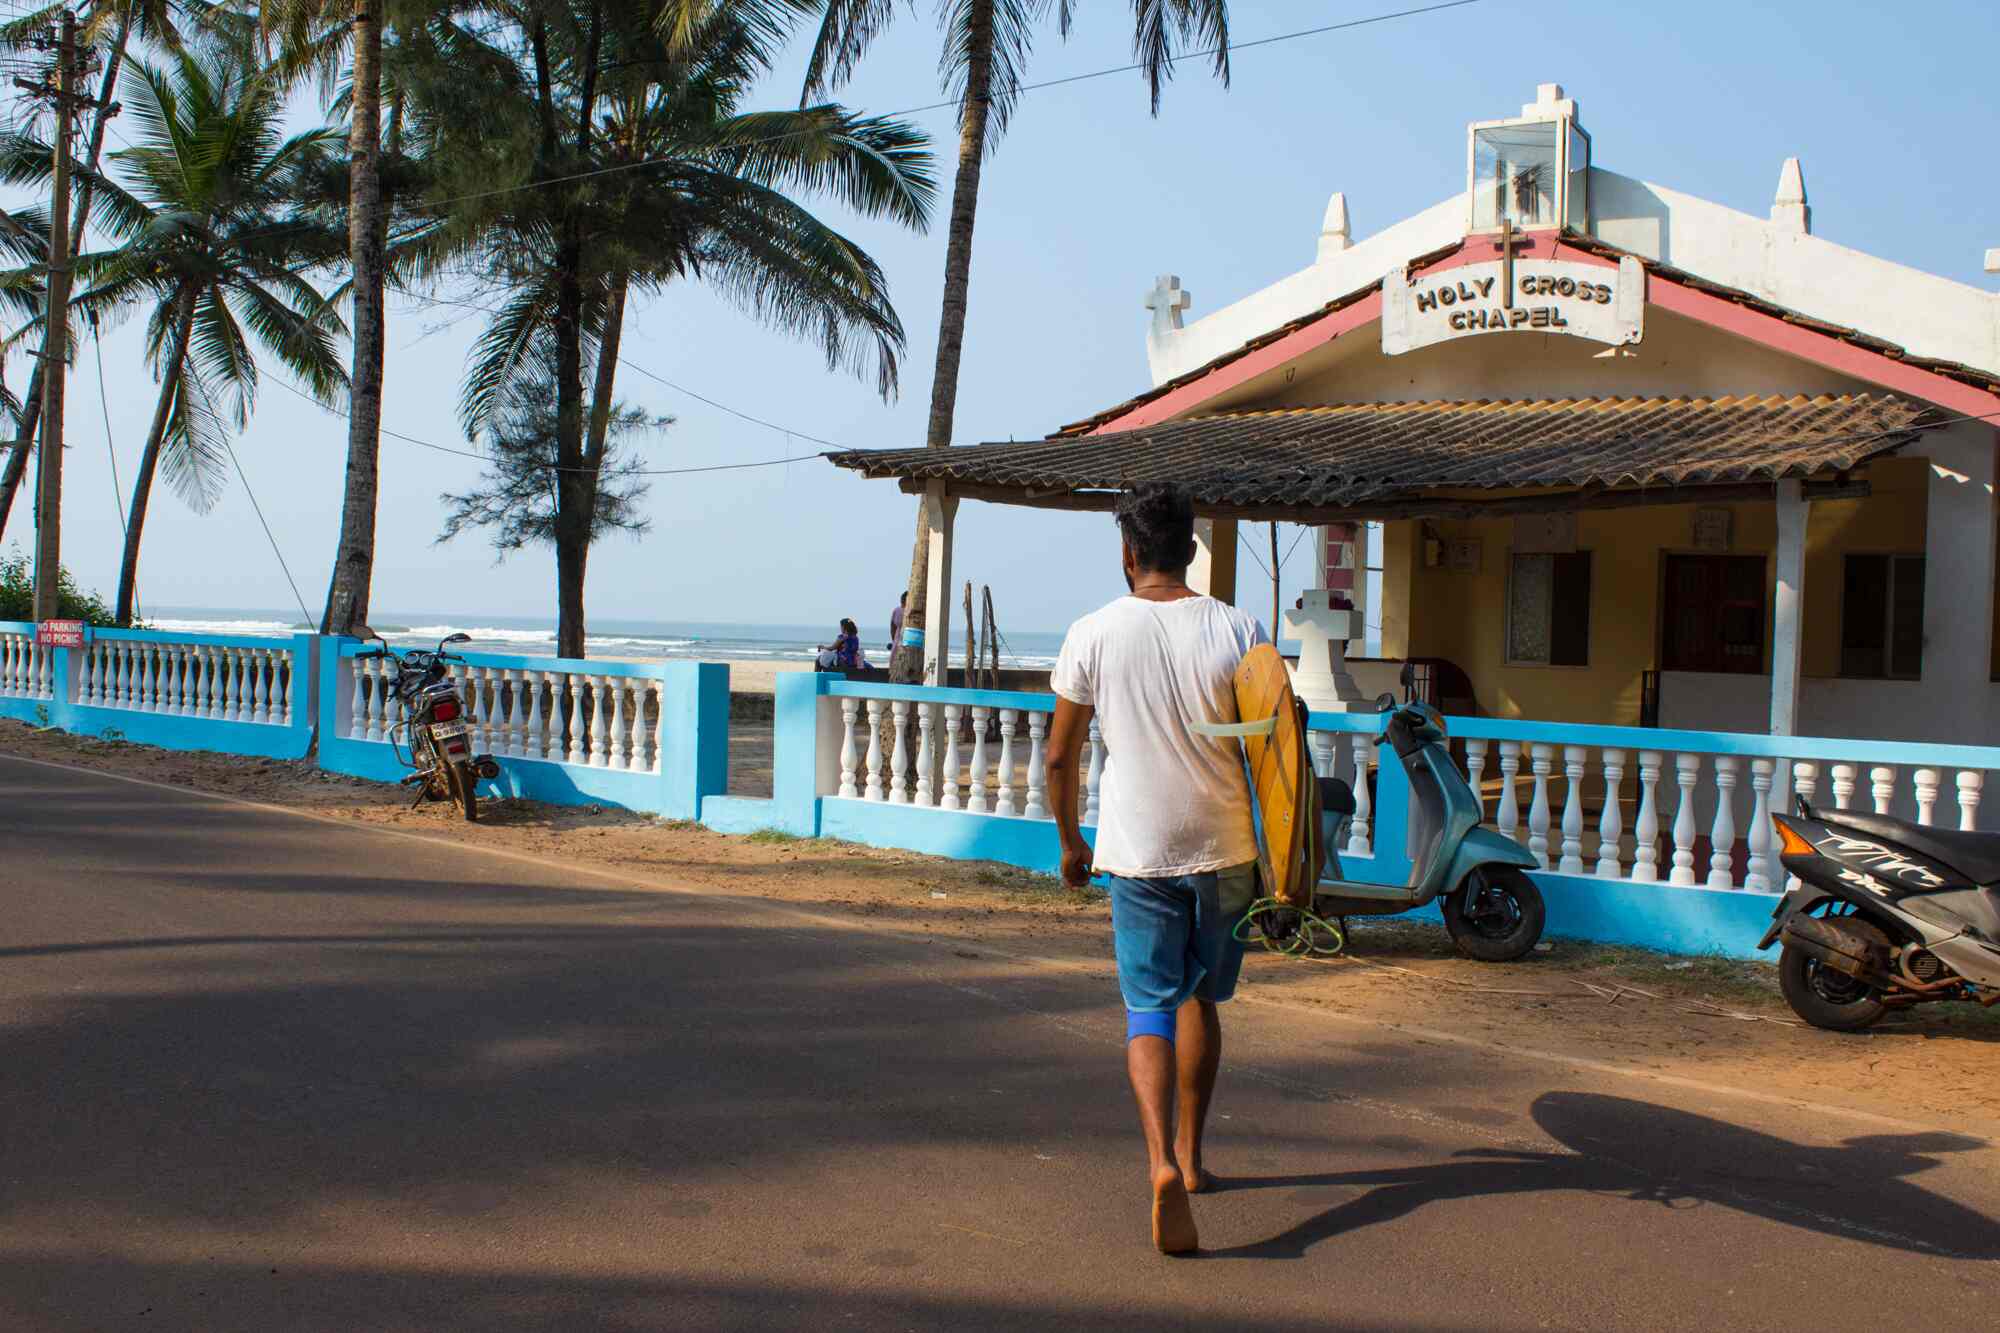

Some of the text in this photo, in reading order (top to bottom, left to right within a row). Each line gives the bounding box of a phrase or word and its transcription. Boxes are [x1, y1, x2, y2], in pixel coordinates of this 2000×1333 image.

[1416, 274, 1613, 313] HOLY CROSS
[1448, 306, 1568, 330] CHAPEL
[38, 622, 83, 633] NO PARKING
[40, 633, 52, 643] NO
